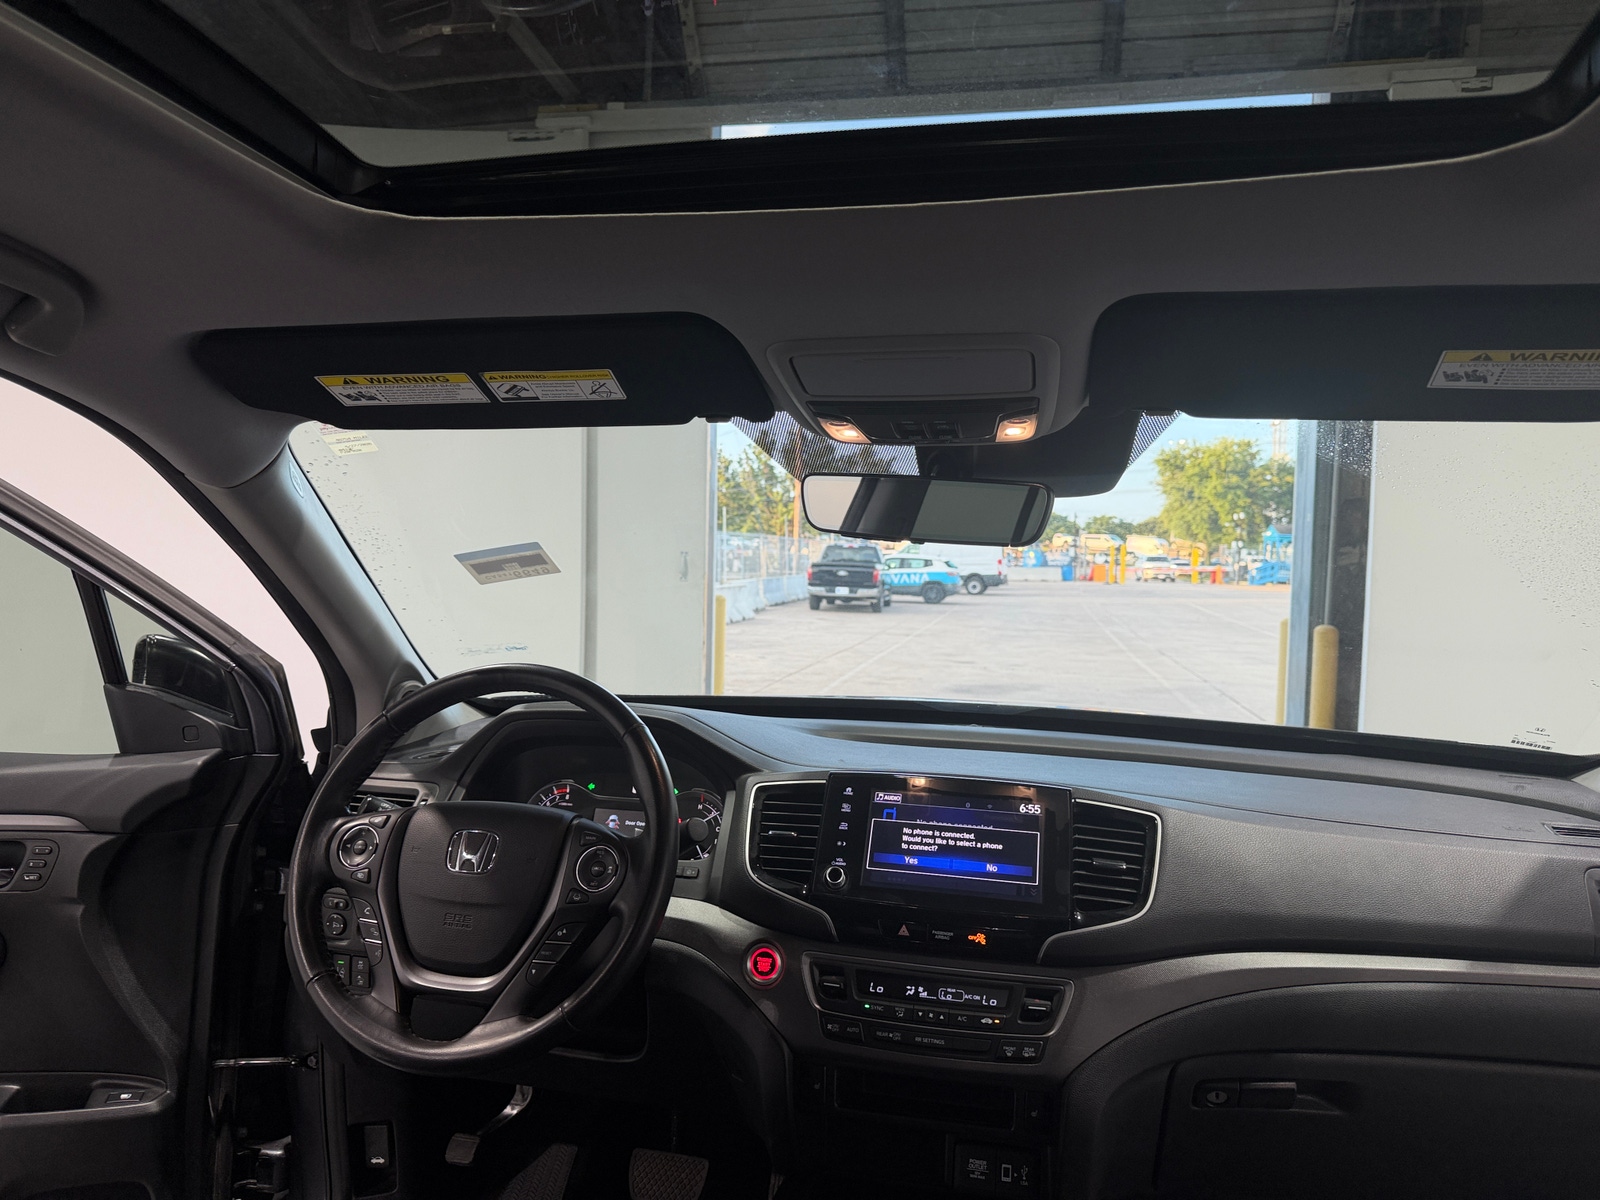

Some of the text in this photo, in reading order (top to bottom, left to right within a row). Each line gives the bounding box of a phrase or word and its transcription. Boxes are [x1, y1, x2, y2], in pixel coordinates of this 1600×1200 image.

[363, 375, 450, 385] WARNING
[885, 573, 929, 585] VANA
[1019, 803, 1041, 814] 6:55
[913, 828, 933, 836] phone
[941, 831, 976, 840] connected.
[902, 835, 921, 843] Would
[922, 837, 934, 845] you
[935, 837, 947, 845] like
[956, 839, 976, 847] select
[982, 842, 1003, 850] phone
[909, 844, 938, 852] connect?
[904, 856, 919, 865] Yes
[986, 864, 998, 872] No
[869, 982, 884, 993] Lo
[941, 991, 953, 1000] Lo
[982, 995, 998, 1006] Lo
[922, 1037, 945, 1045] SETTINGS
[968, 1163, 988, 1171] OUTLET
